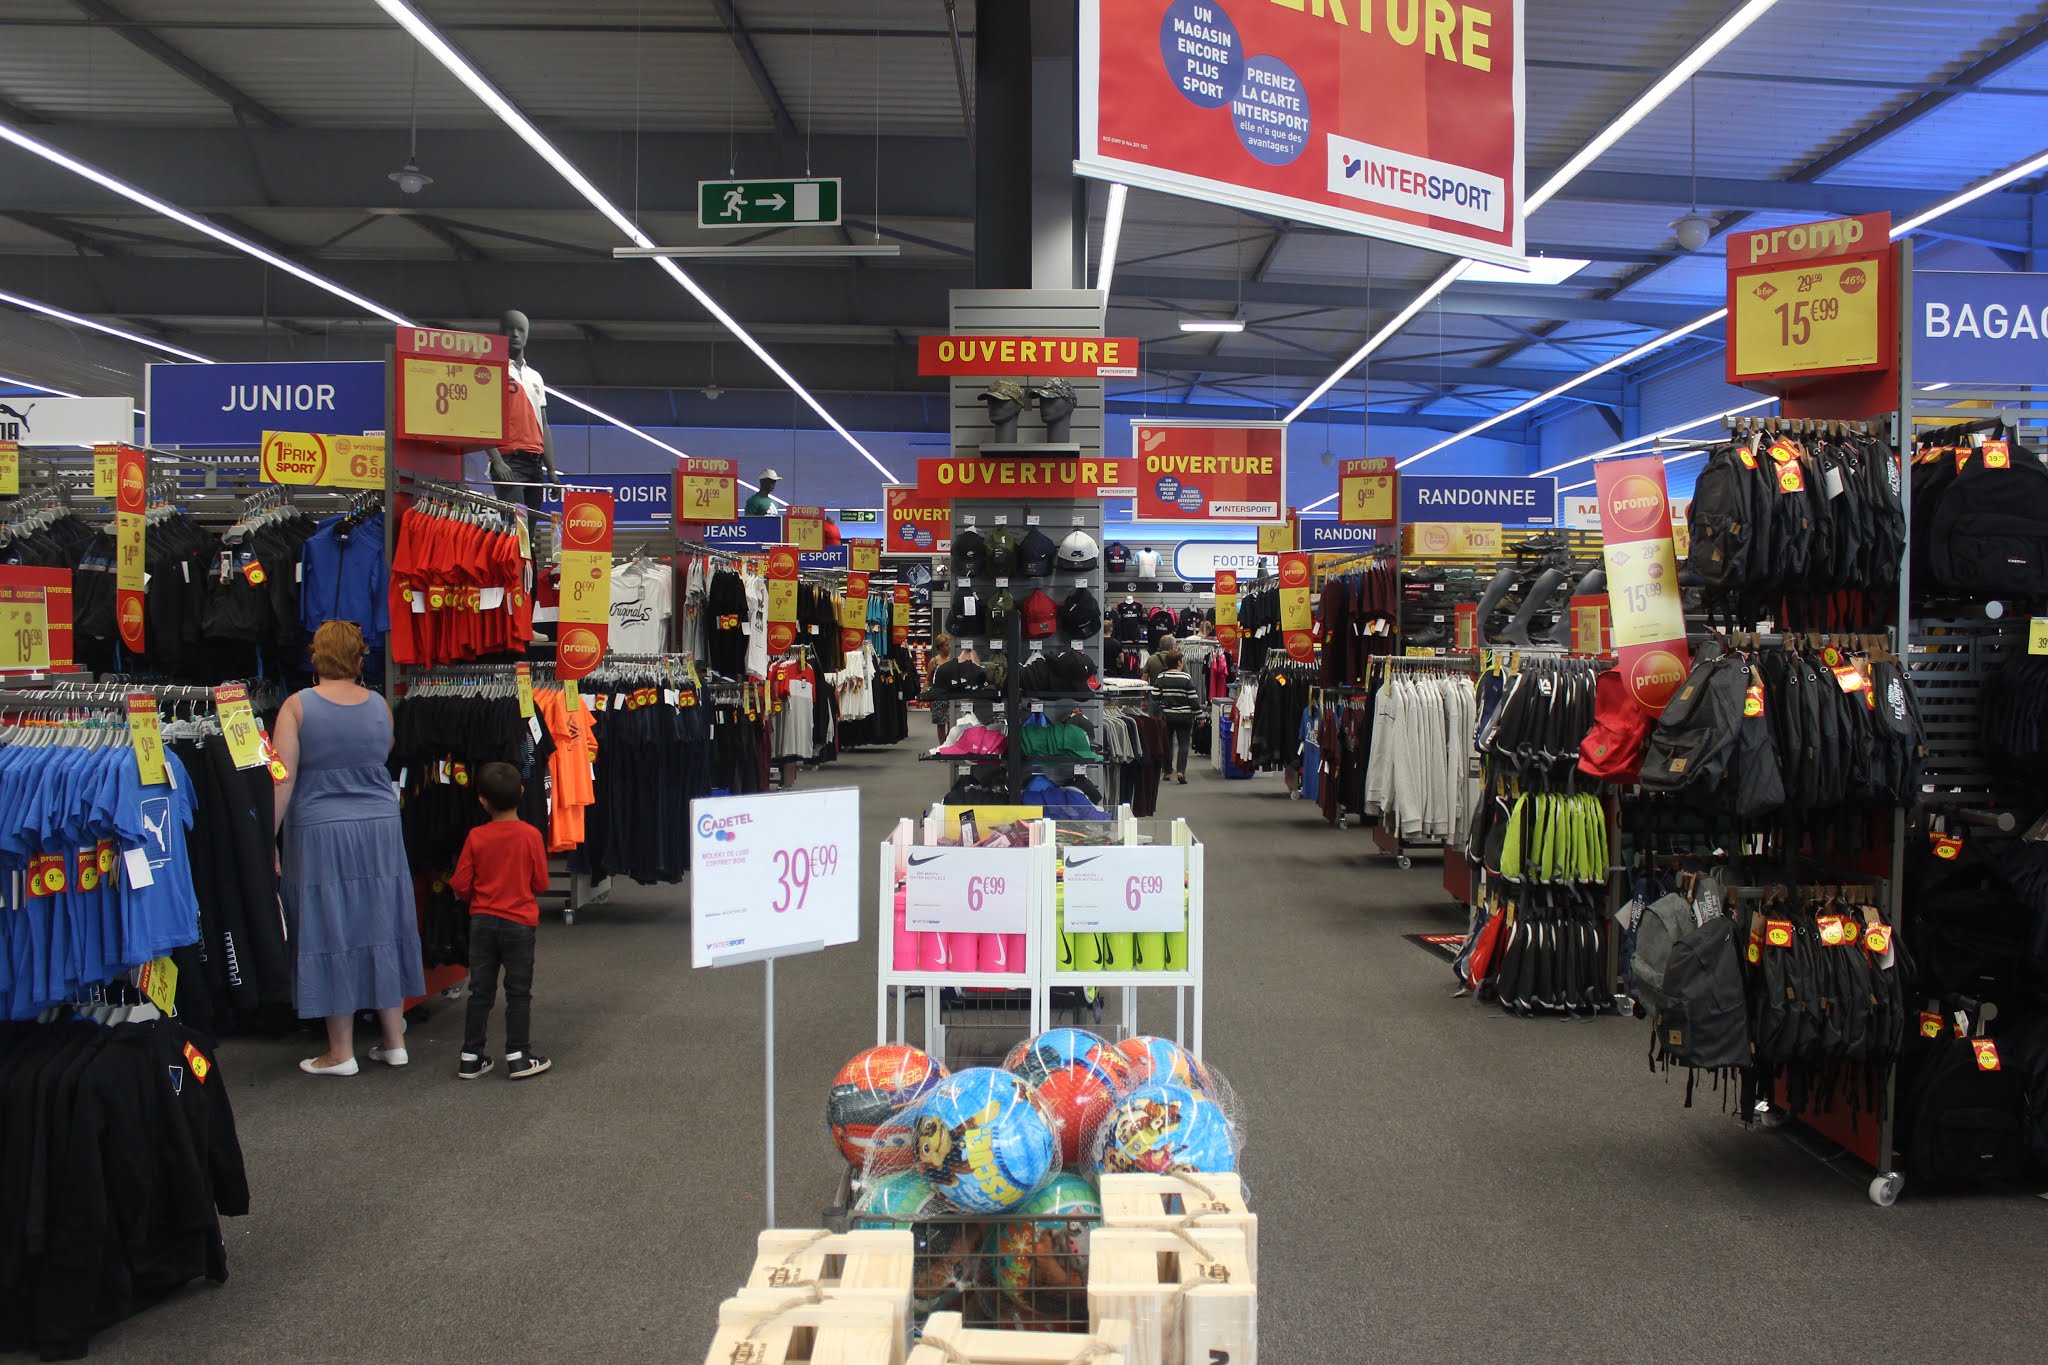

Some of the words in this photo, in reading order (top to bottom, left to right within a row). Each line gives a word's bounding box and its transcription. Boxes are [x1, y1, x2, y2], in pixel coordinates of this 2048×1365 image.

[1194, 6, 1212, 23] UN
[1174, 18, 1231, 47] MAGASIN
[1178, 37, 1228, 64] ENCORE
[1187, 59, 1219, 79] PLUS
[1183, 76, 1224, 99] SPORT
[1247, 68, 1296, 92] PRENEZ
[1242, 85, 1259, 101] LA
[1261, 91, 1300, 112] CARTE
[1233, 101, 1308, 132] INTERSPORT
[1240, 121, 1255, 132] elle
[1257, 125, 1270, 136] n'a
[1271, 129, 1287, 142] que
[1288, 132, 1302, 143] des
[1248, 136, 1288, 153] avantages
[1364, 160, 1491, 212] INTERSPORT
[1751, 218, 1863, 263] promo
[1840, 275, 1866, 286] -46%
[1774, 297, 1838, 346] 15€99
[414, 330, 492, 353] promo
[938, 341, 1119, 363] OUVERTURE
[221, 384, 336, 412] JUNIOR
[436, 383, 467, 415] 8€99
[276, 463, 315, 473] SPORT
[688, 459, 729, 472] promo
[938, 463, 1119, 484] OUVERTURE
[1147, 456, 1273, 474] OUVERTURE
[1347, 458, 1387, 474] promo
[123, 478, 142, 489] promo
[1418, 489, 1536, 506] RANDONNEE
[1613, 495, 1659, 514] promo
[792, 506, 819, 515] promo
[570, 519, 602, 528] promo
[704, 526, 746, 537] JEANS
[798, 552, 806, 561] E
[809, 552, 842, 561] SPORT
[0, 590, 12, 598] TURE
[16, 591, 44, 599] OUVERTURE
[123, 613, 141, 624] promo
[564, 645, 597, 653] promo
[1636, 669, 1680, 690] promo
[130, 700, 157, 708] OUVERTURE
[702, 813, 753, 833] CADETEL
[40, 855, 64, 863] promo
[736, 849, 750, 857] LUXE
[706, 859, 731, 867] COFFRET
[772, 844, 837, 914] 39€99
[967, 876, 1005, 911] 6€99
[1125, 876, 1162, 911] 6€99
[712, 938, 745, 949] INTERSPORT
